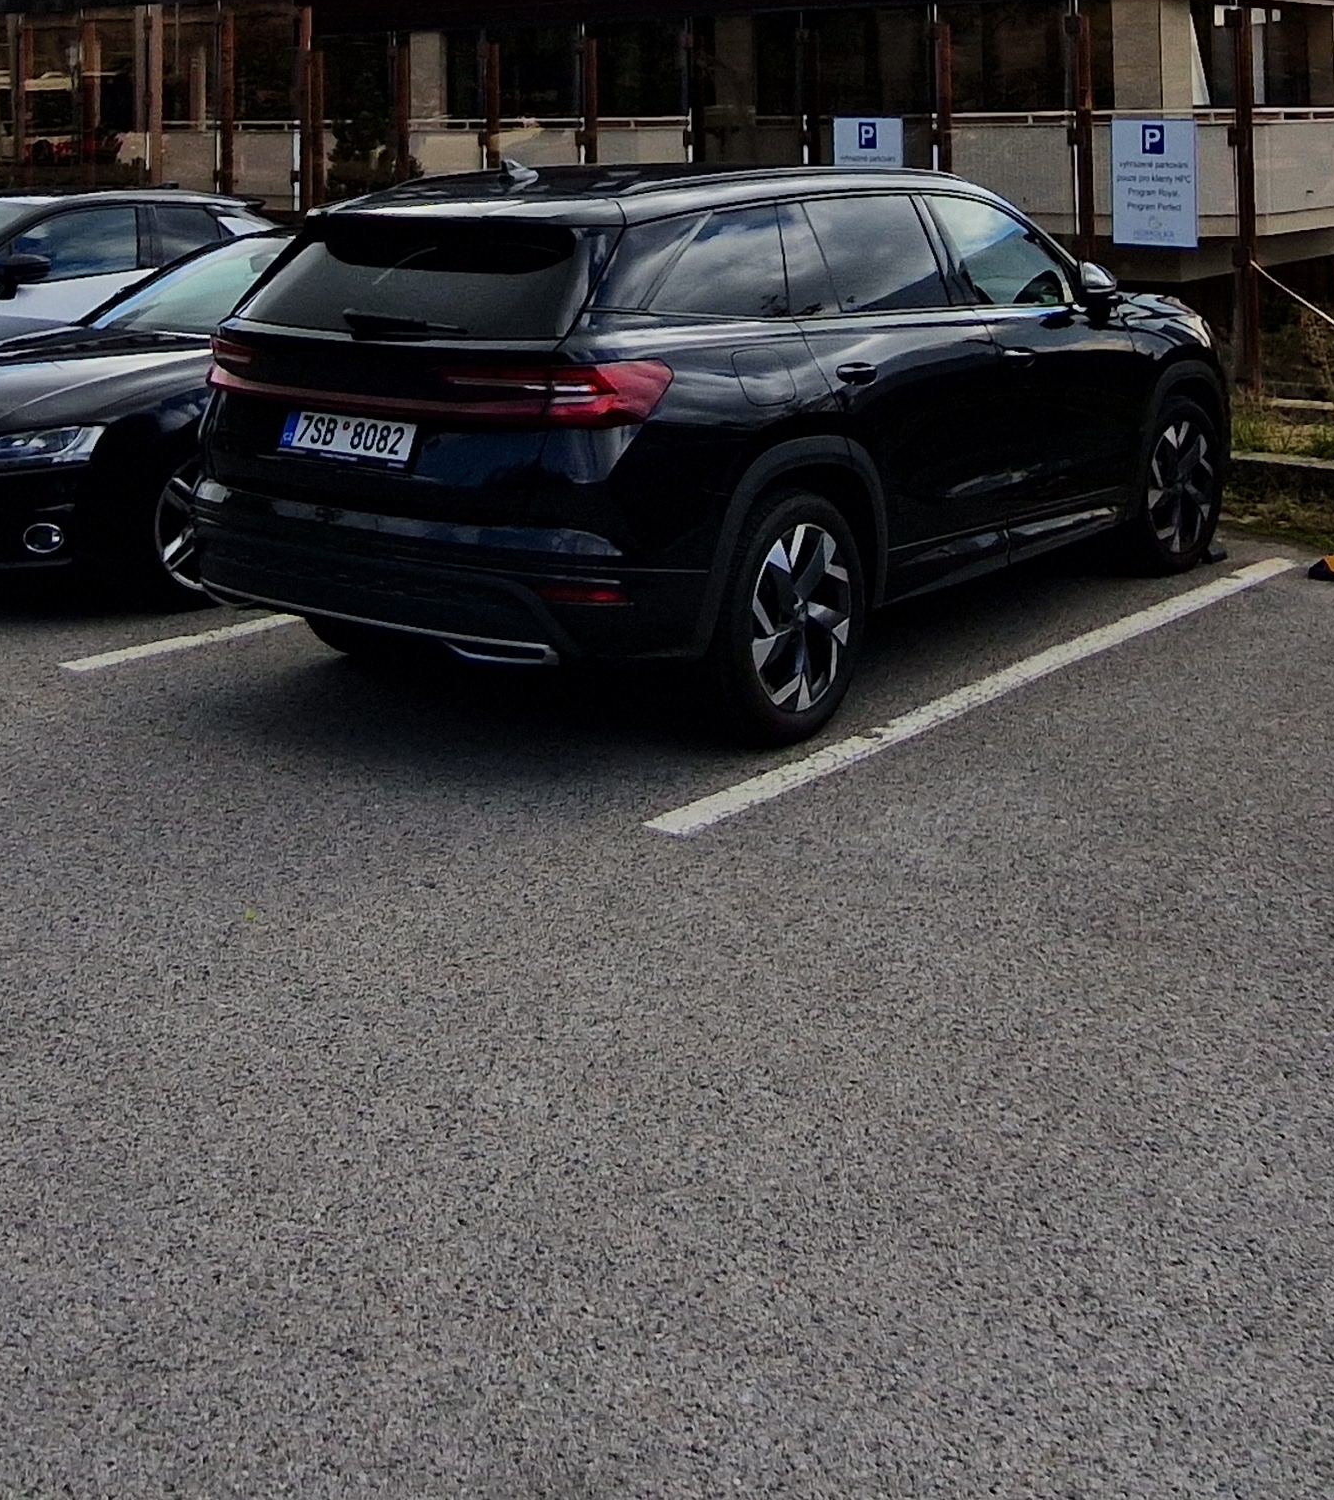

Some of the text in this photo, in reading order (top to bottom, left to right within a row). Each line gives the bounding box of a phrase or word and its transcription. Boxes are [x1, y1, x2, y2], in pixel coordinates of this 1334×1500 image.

[861, 125, 874, 146] P
[1145, 128, 1161, 150] P
[1128, 187, 1156, 198] Program
[1127, 201, 1156, 212] Program
[297, 414, 405, 456] 7SB 8082
